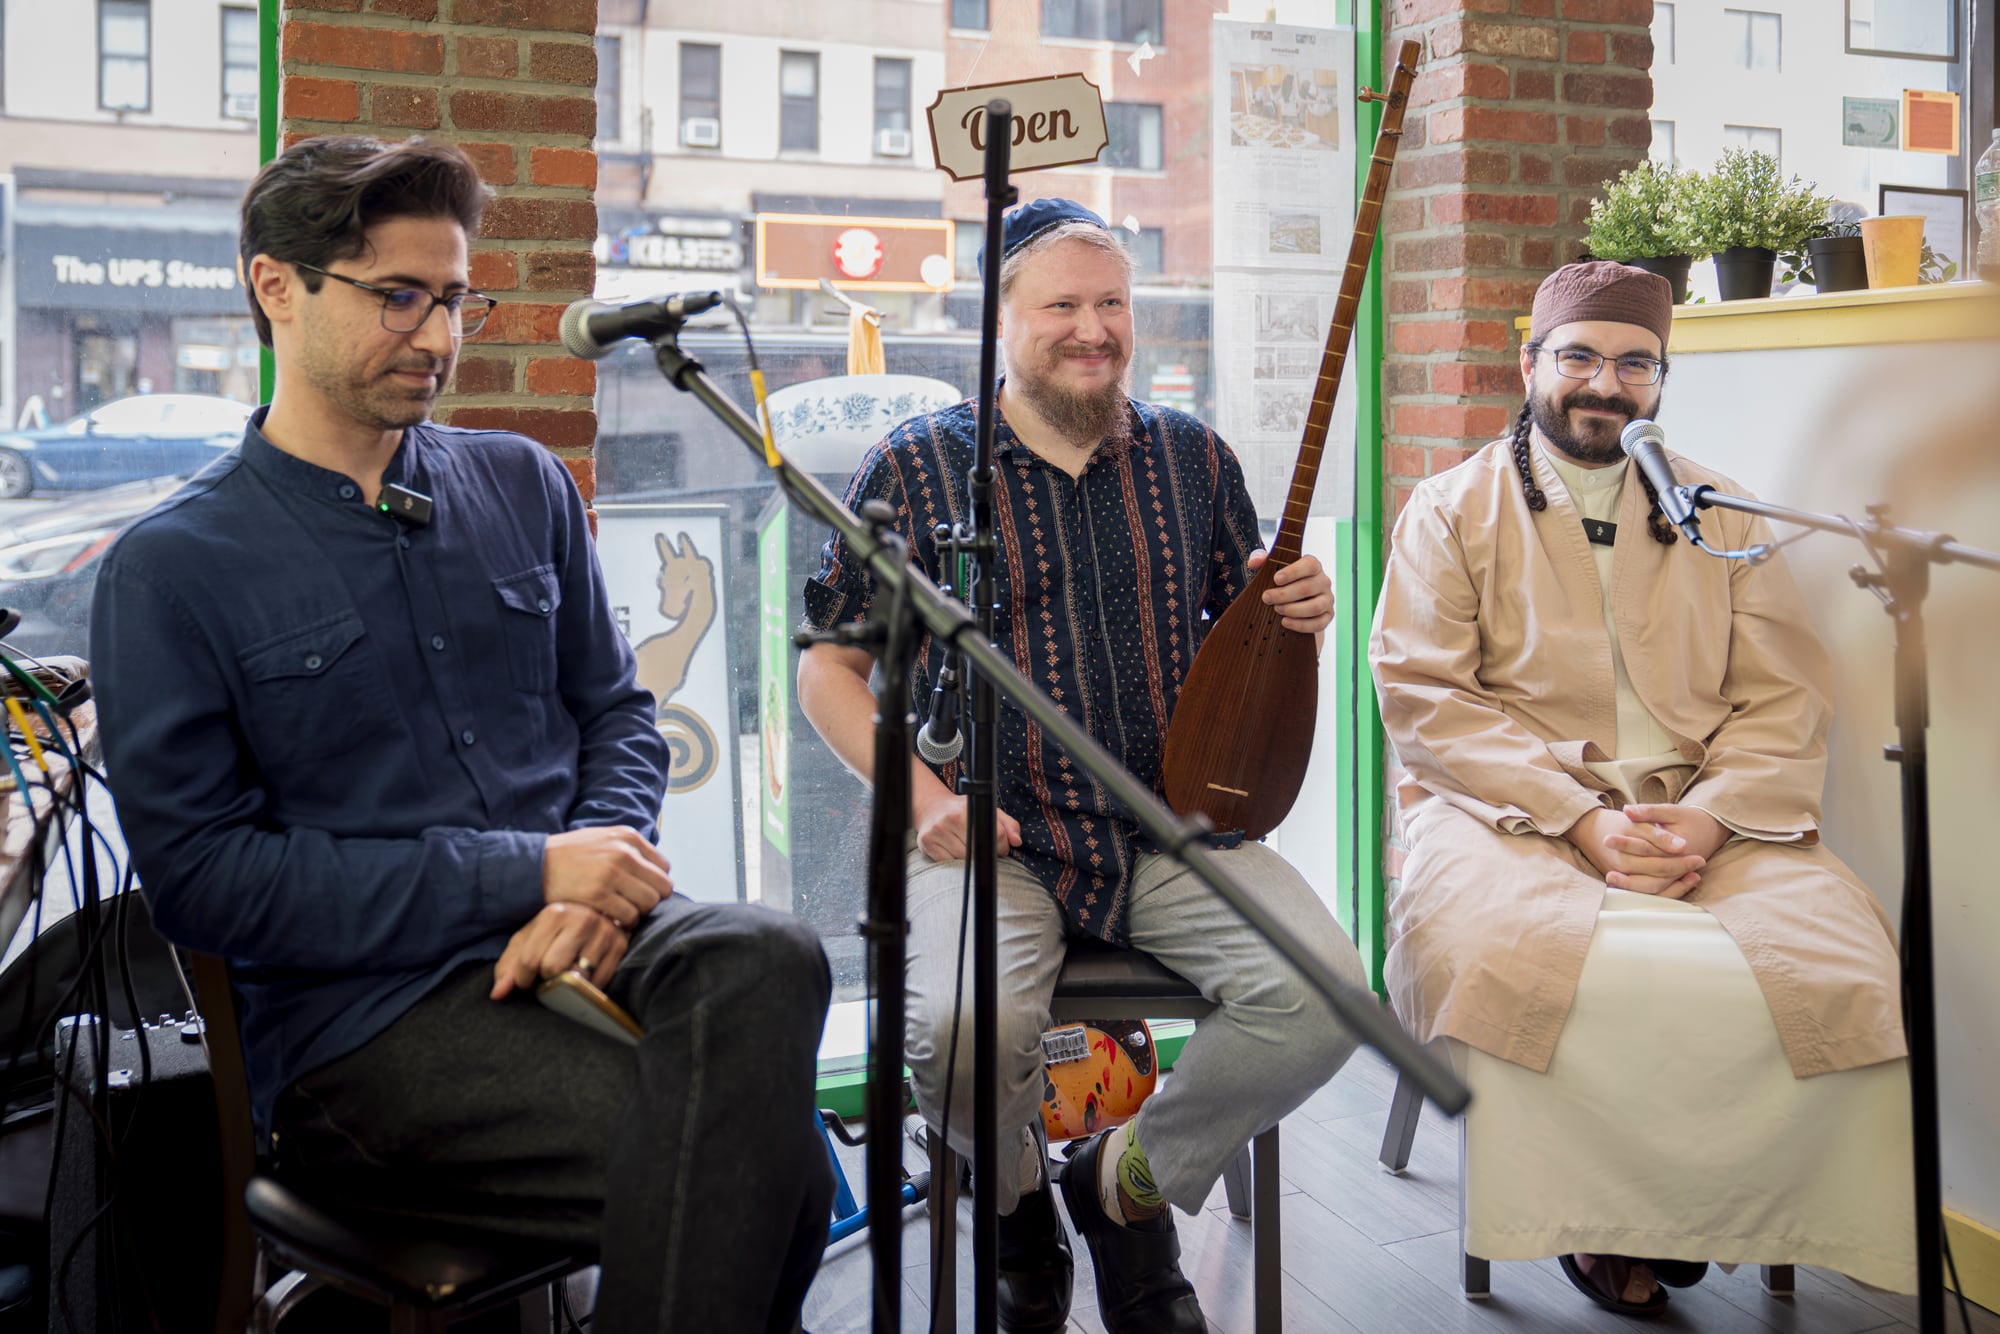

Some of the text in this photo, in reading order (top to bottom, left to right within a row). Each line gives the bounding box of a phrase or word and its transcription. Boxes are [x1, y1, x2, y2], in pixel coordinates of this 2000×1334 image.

[52, 254, 236, 290] The UPS Store
